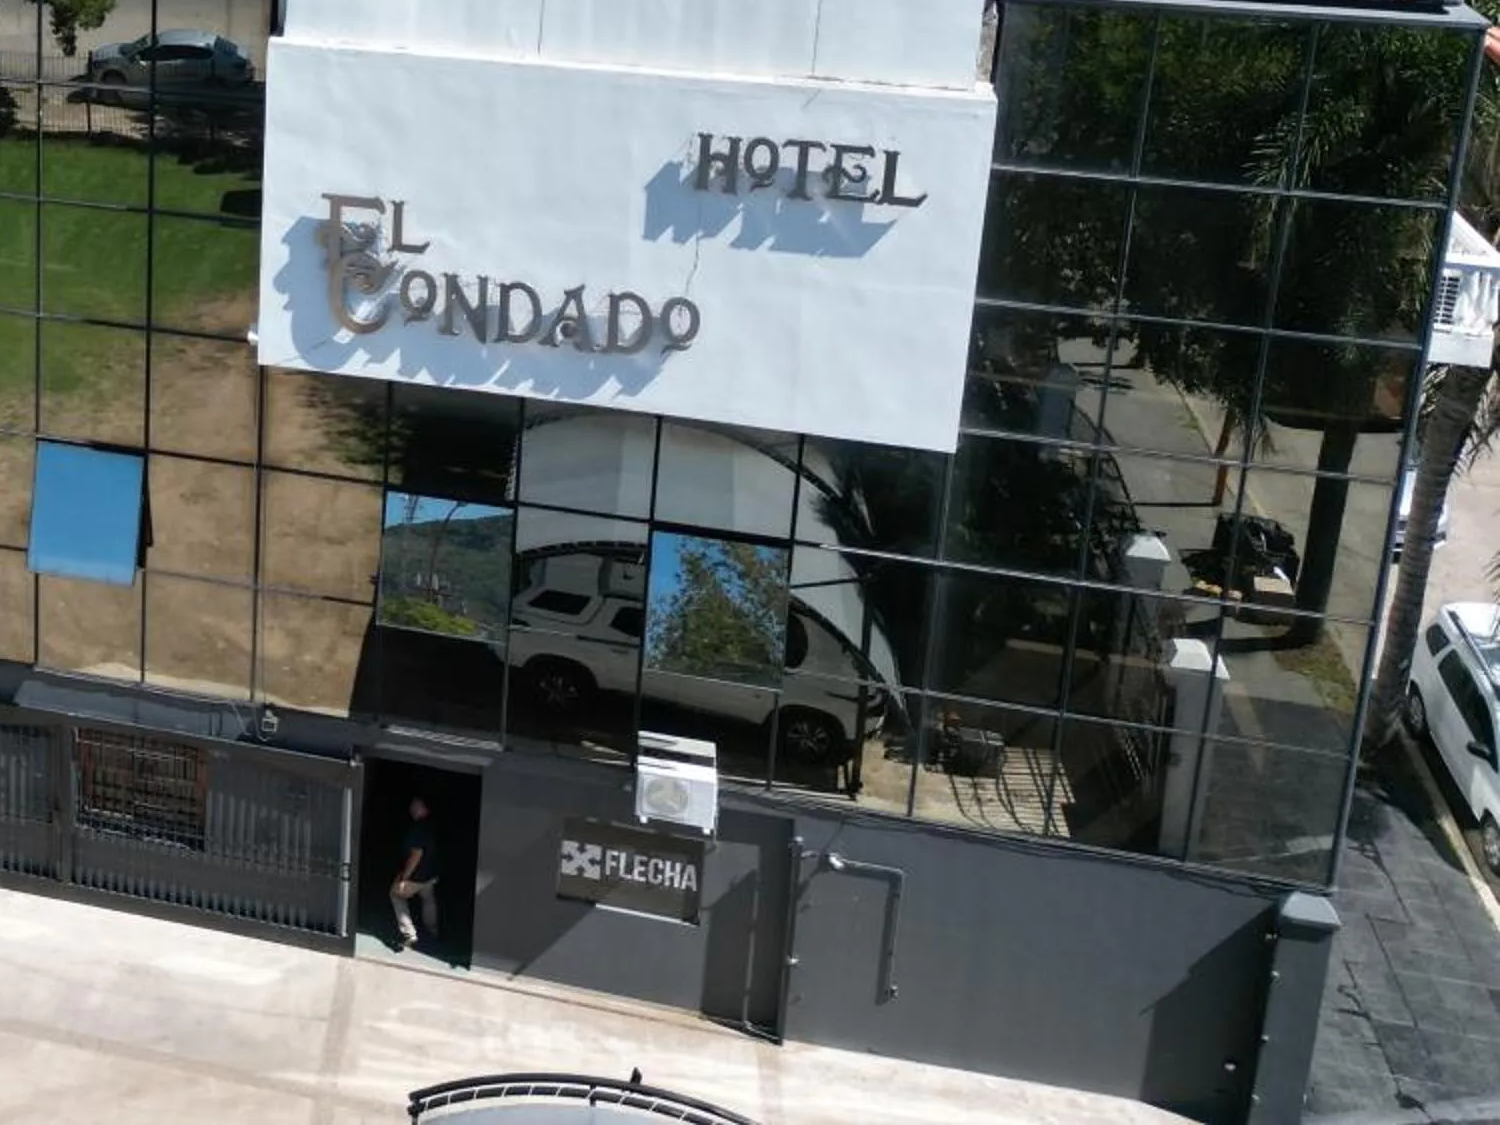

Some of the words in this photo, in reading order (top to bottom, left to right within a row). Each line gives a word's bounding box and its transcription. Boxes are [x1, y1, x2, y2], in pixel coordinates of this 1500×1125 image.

[693, 132, 928, 208] HOTEL
[316, 191, 431, 269] EL
[328, 251, 701, 357] CONDADO
[605, 849, 698, 892] FLECHA
